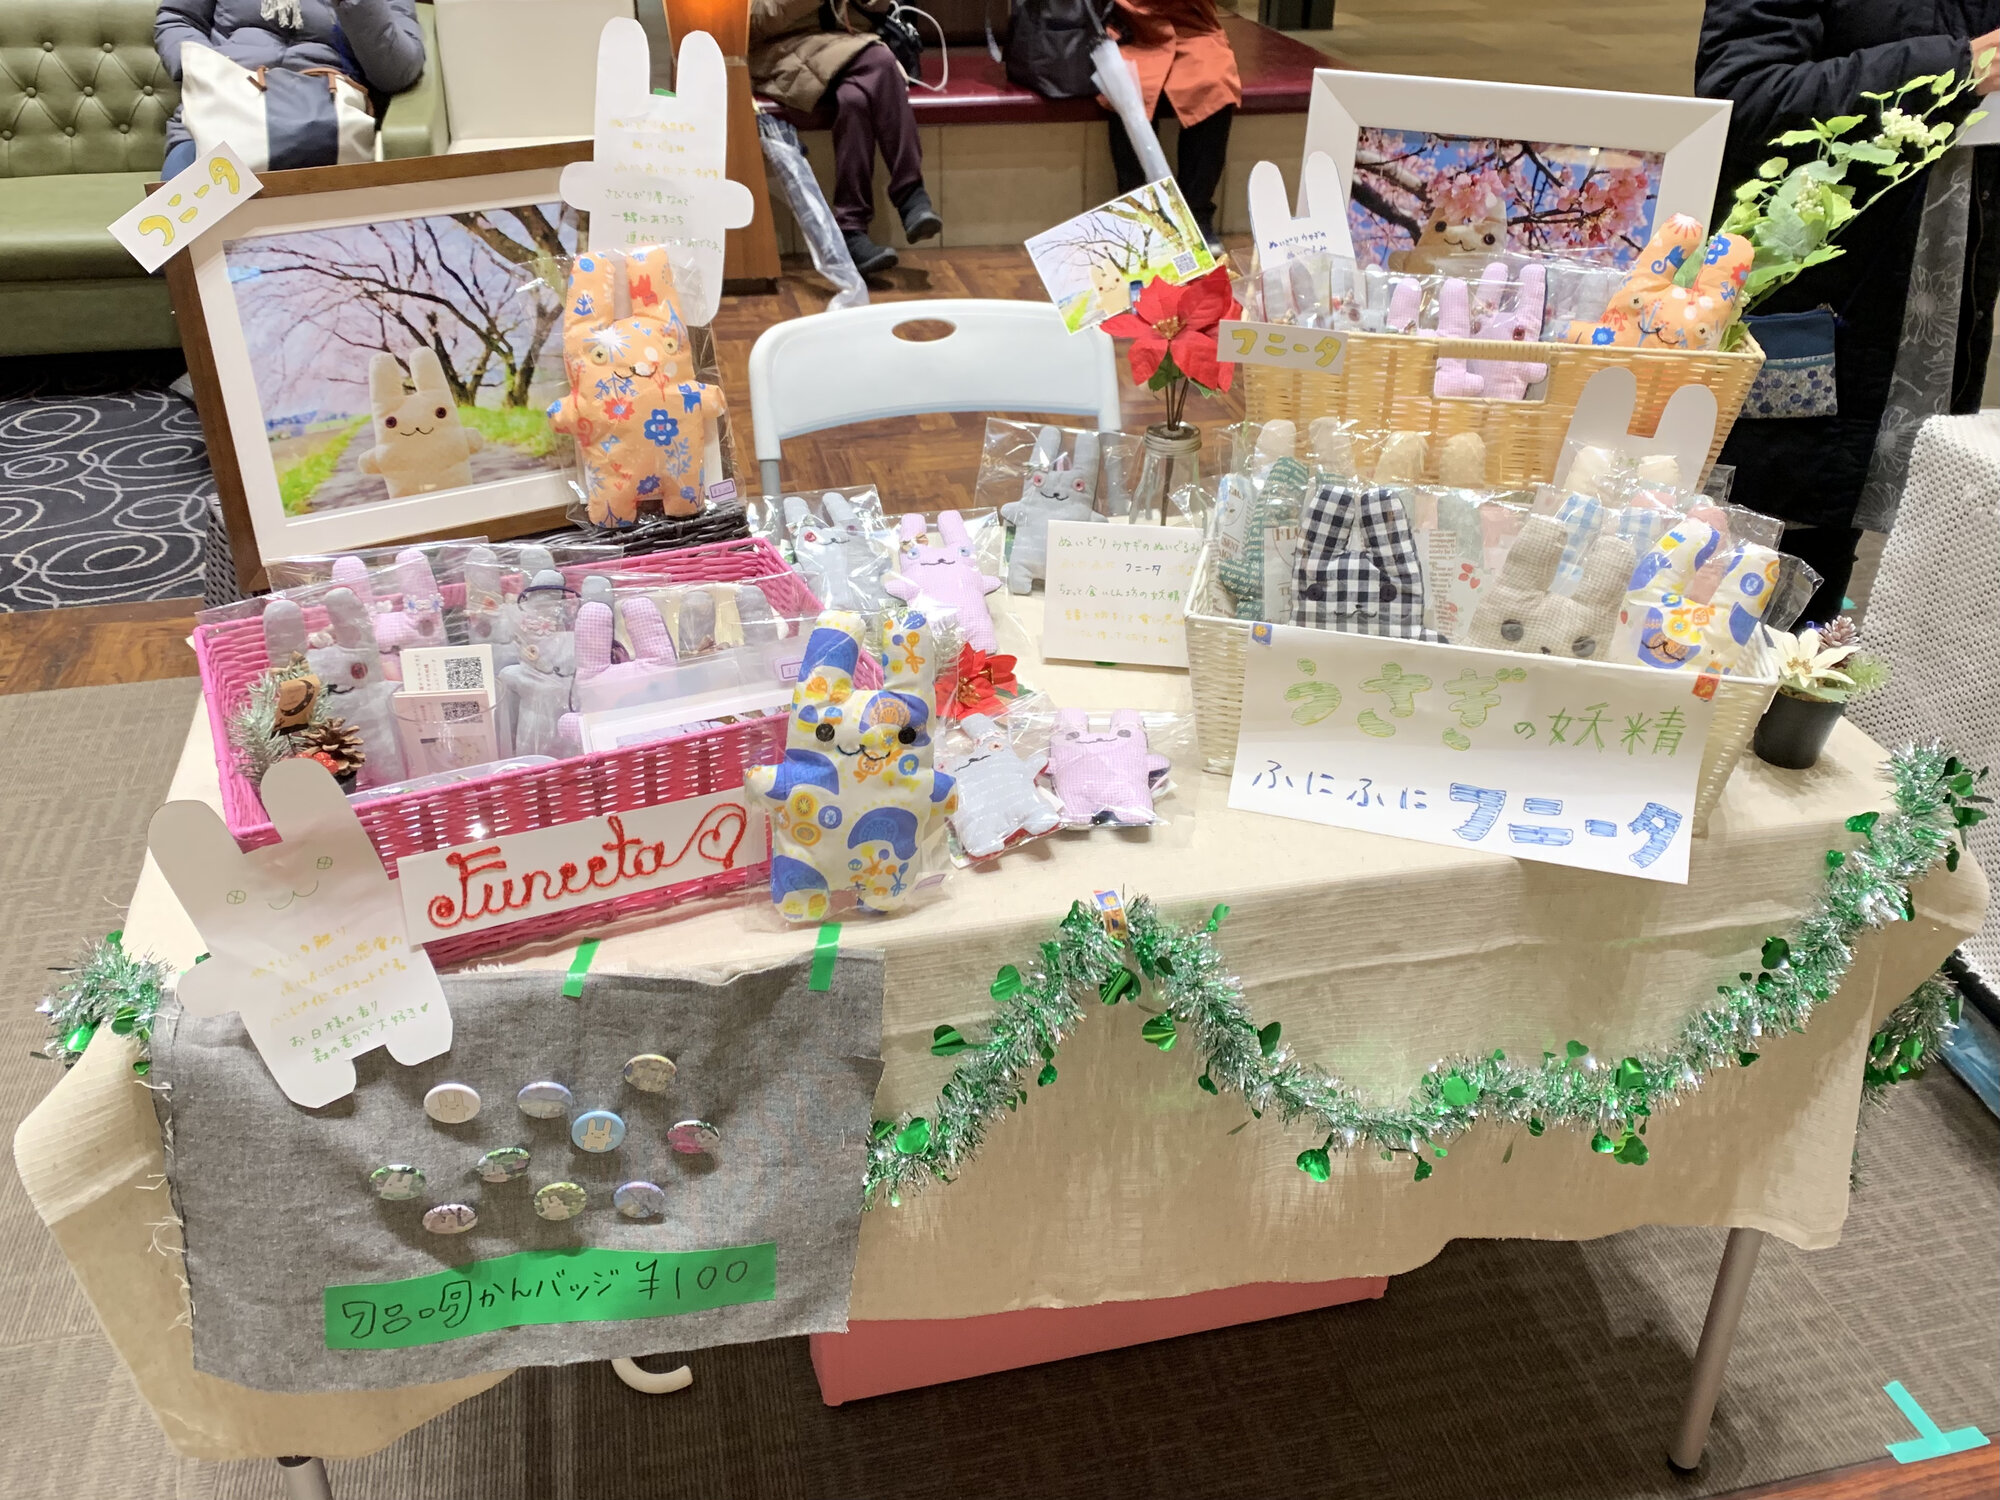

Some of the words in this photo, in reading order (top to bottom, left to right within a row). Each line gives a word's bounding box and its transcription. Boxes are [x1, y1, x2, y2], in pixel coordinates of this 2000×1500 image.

[138, 157, 240, 246] フニータ
[1231, 328, 1342, 368] フニータ
[1125, 563, 1162, 577] フニータ
[1283, 657, 1688, 757] うさぎの妖精
[1251, 759, 1684, 869] ふにふにフニータ
[635, 1258, 749, 1301] ¥100
